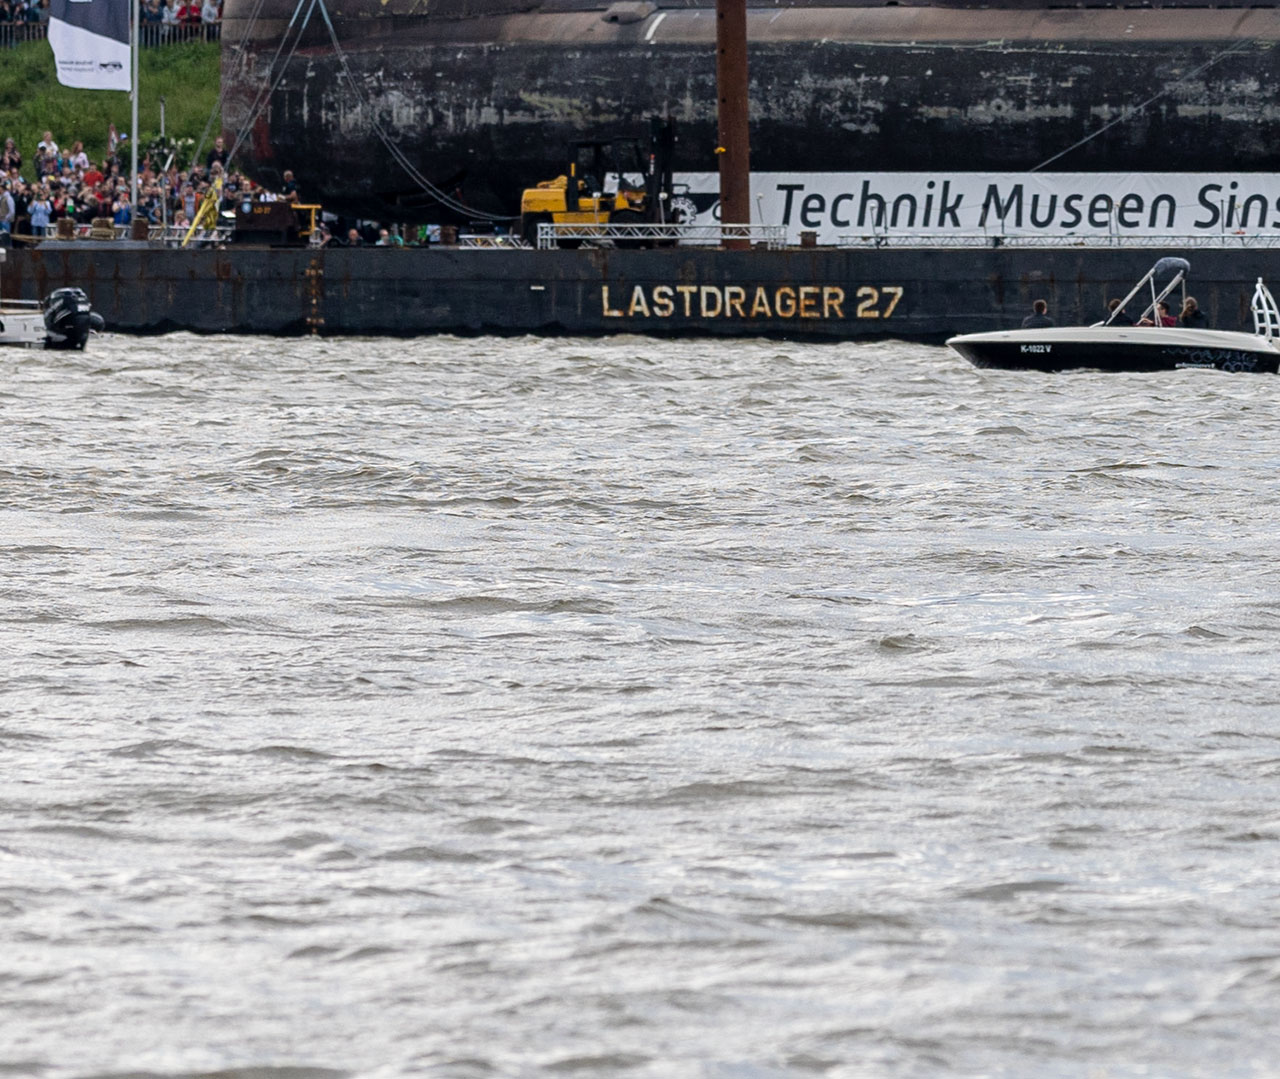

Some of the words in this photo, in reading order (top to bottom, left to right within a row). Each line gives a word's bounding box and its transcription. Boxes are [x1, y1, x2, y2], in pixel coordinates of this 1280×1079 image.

[776, 180, 964, 228] Technik
[978, 183, 1177, 229] Museen
[601, 285, 846, 319] LASTDRAGER
[856, 286, 904, 319] 27
